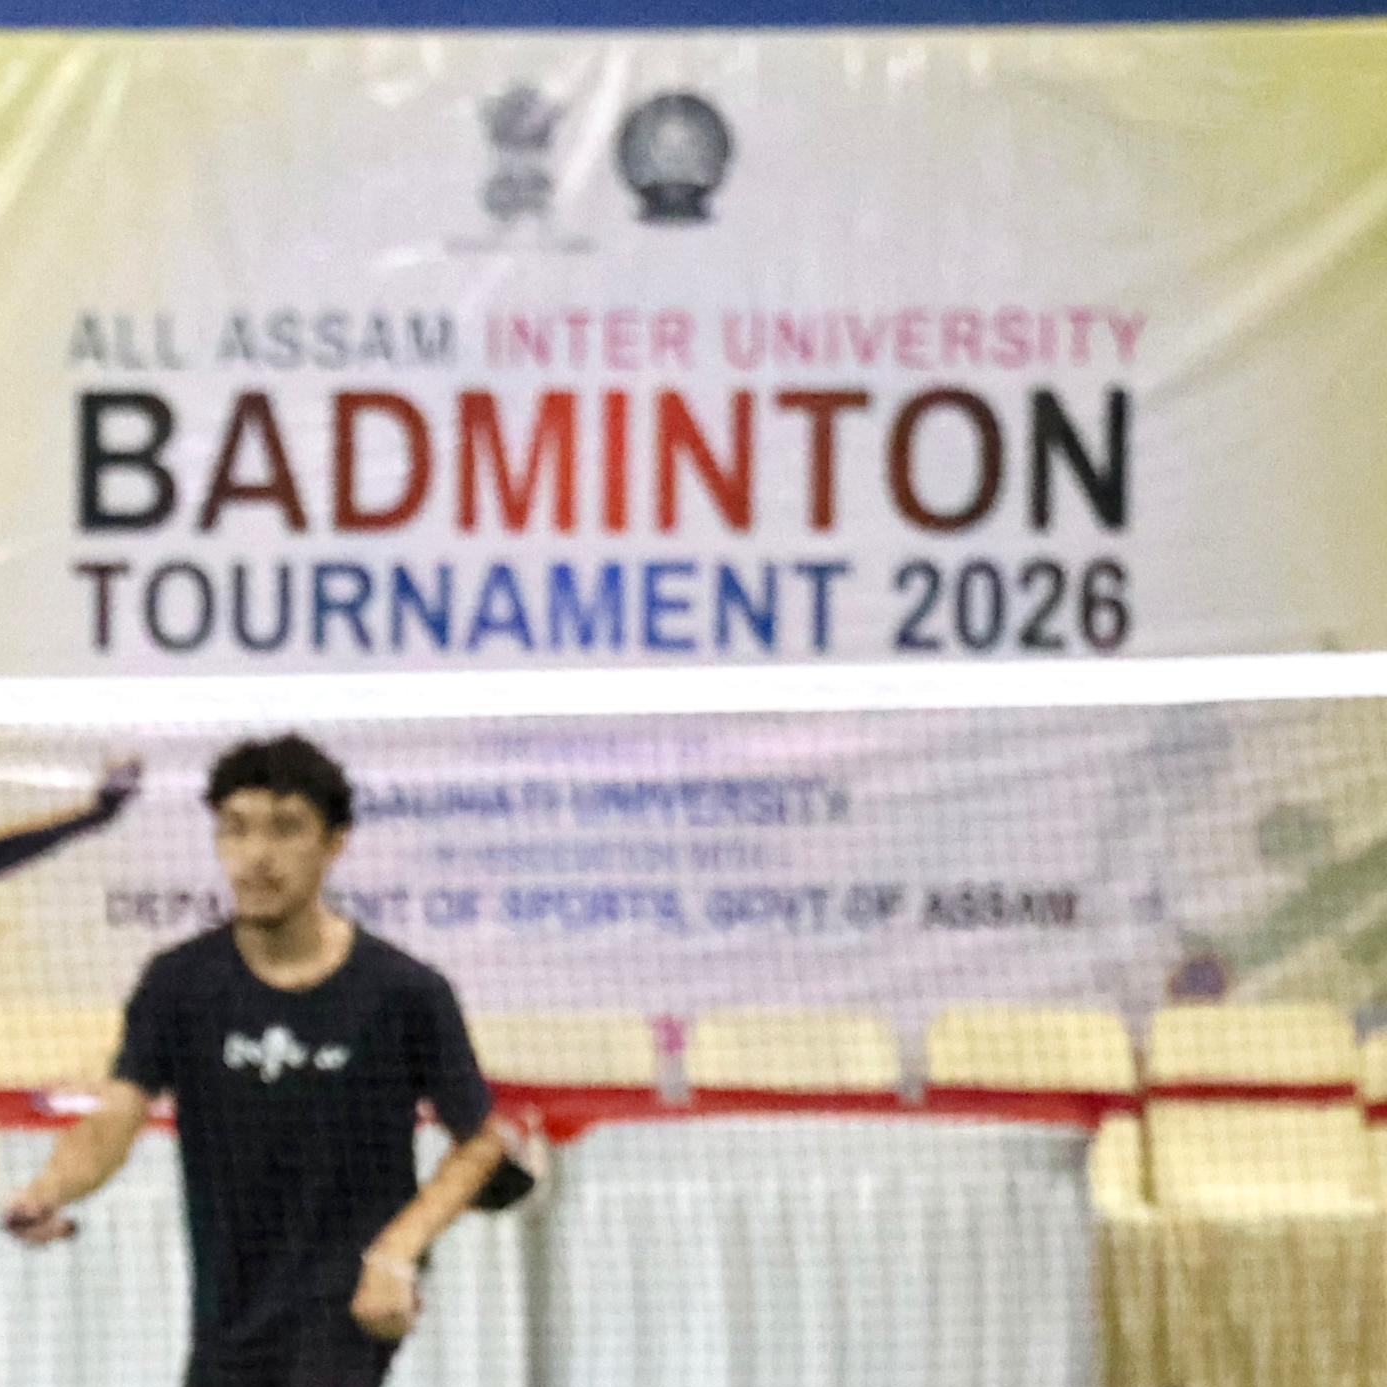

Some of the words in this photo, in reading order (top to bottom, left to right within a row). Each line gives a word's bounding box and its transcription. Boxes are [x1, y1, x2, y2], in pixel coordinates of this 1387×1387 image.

[70, 312, 185, 371] ALL
[216, 310, 457, 371] ASSAM
[485, 309, 695, 369] INTER
[723, 306, 1147, 369] UNIVERSITY
[74, 387, 1132, 535] BADMINTON
[73, 558, 849, 655] TOURNAMENT
[894, 557, 1131, 653] 2026
